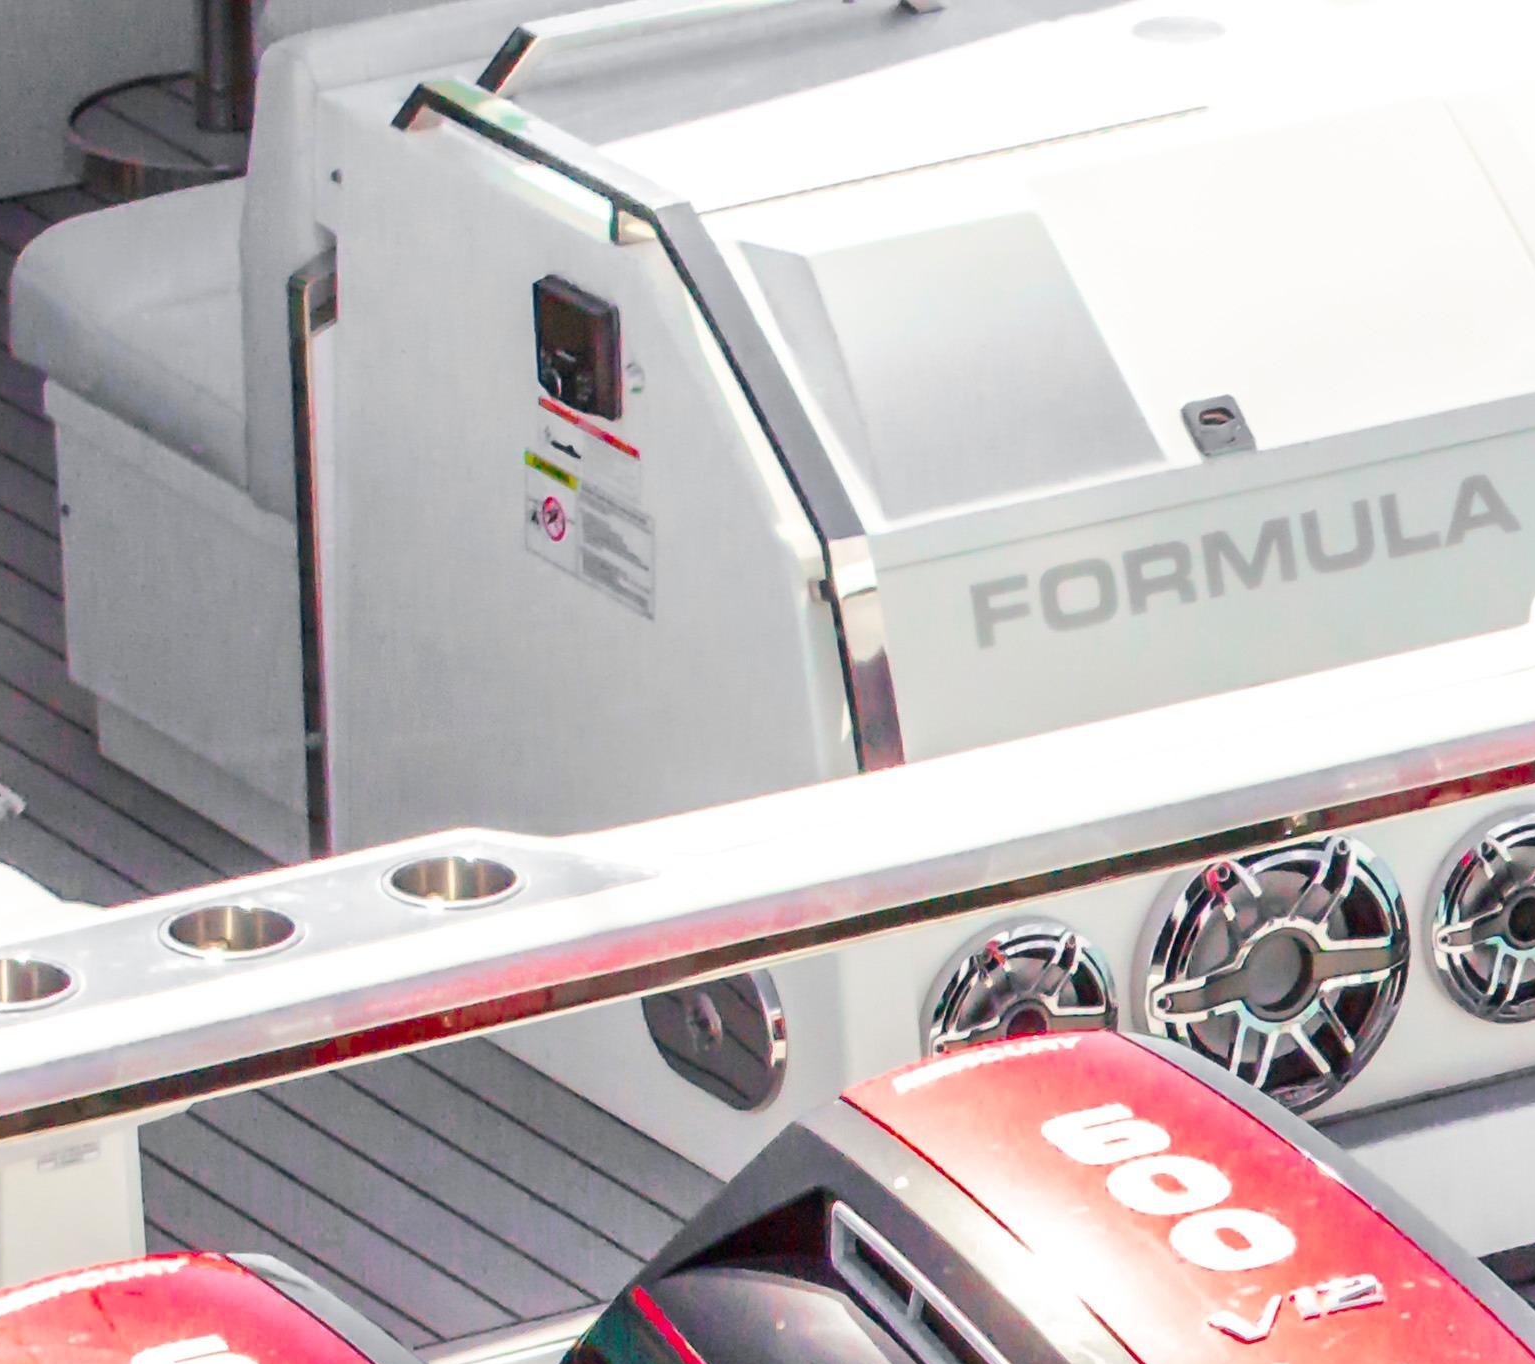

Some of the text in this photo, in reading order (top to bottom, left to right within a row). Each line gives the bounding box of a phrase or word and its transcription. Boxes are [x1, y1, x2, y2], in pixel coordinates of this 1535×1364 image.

[969, 474, 1521, 648] FORMULA
[892, 1036, 1082, 1095] RCURY
[1042, 1104, 1296, 1271] 500
[1208, 1273, 1386, 1344] V12
